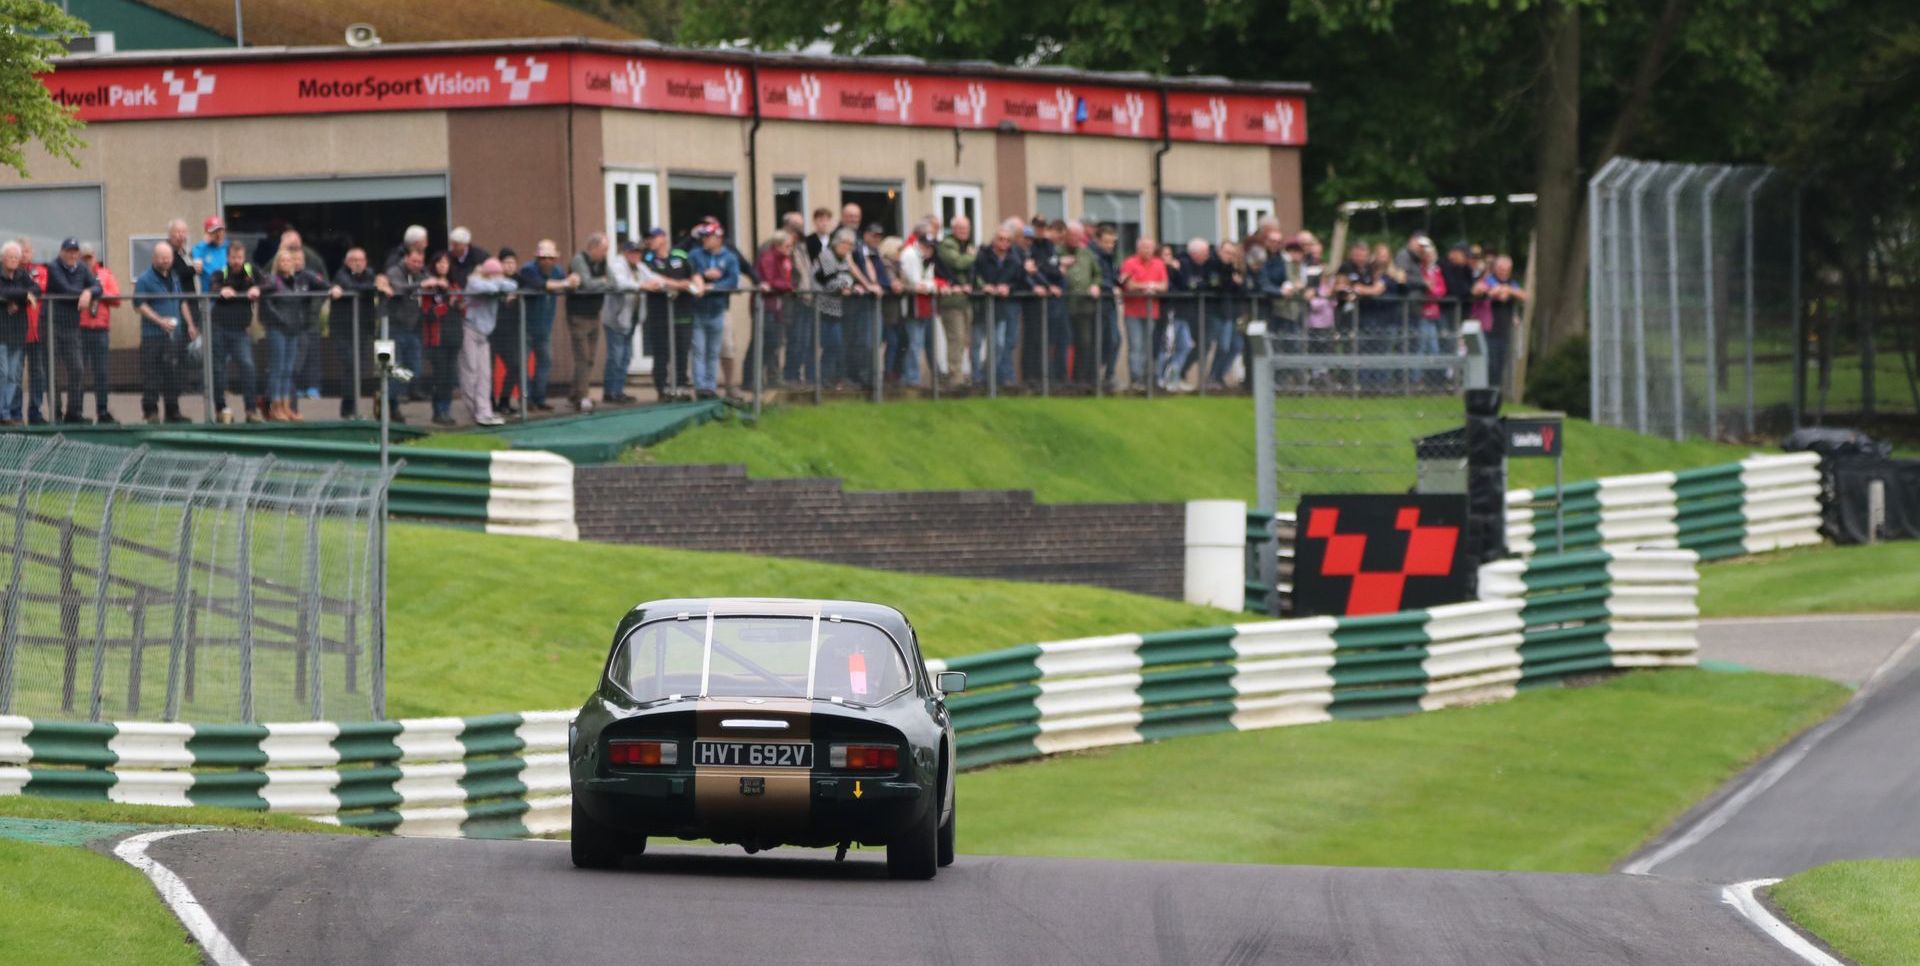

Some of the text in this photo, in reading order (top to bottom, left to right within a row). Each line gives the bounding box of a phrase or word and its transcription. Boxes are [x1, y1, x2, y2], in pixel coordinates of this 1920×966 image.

[52, 84, 157, 107] dwellPark
[298, 71, 490, 100] MotorSportVision
[701, 743, 805, 766] HVT 692V
